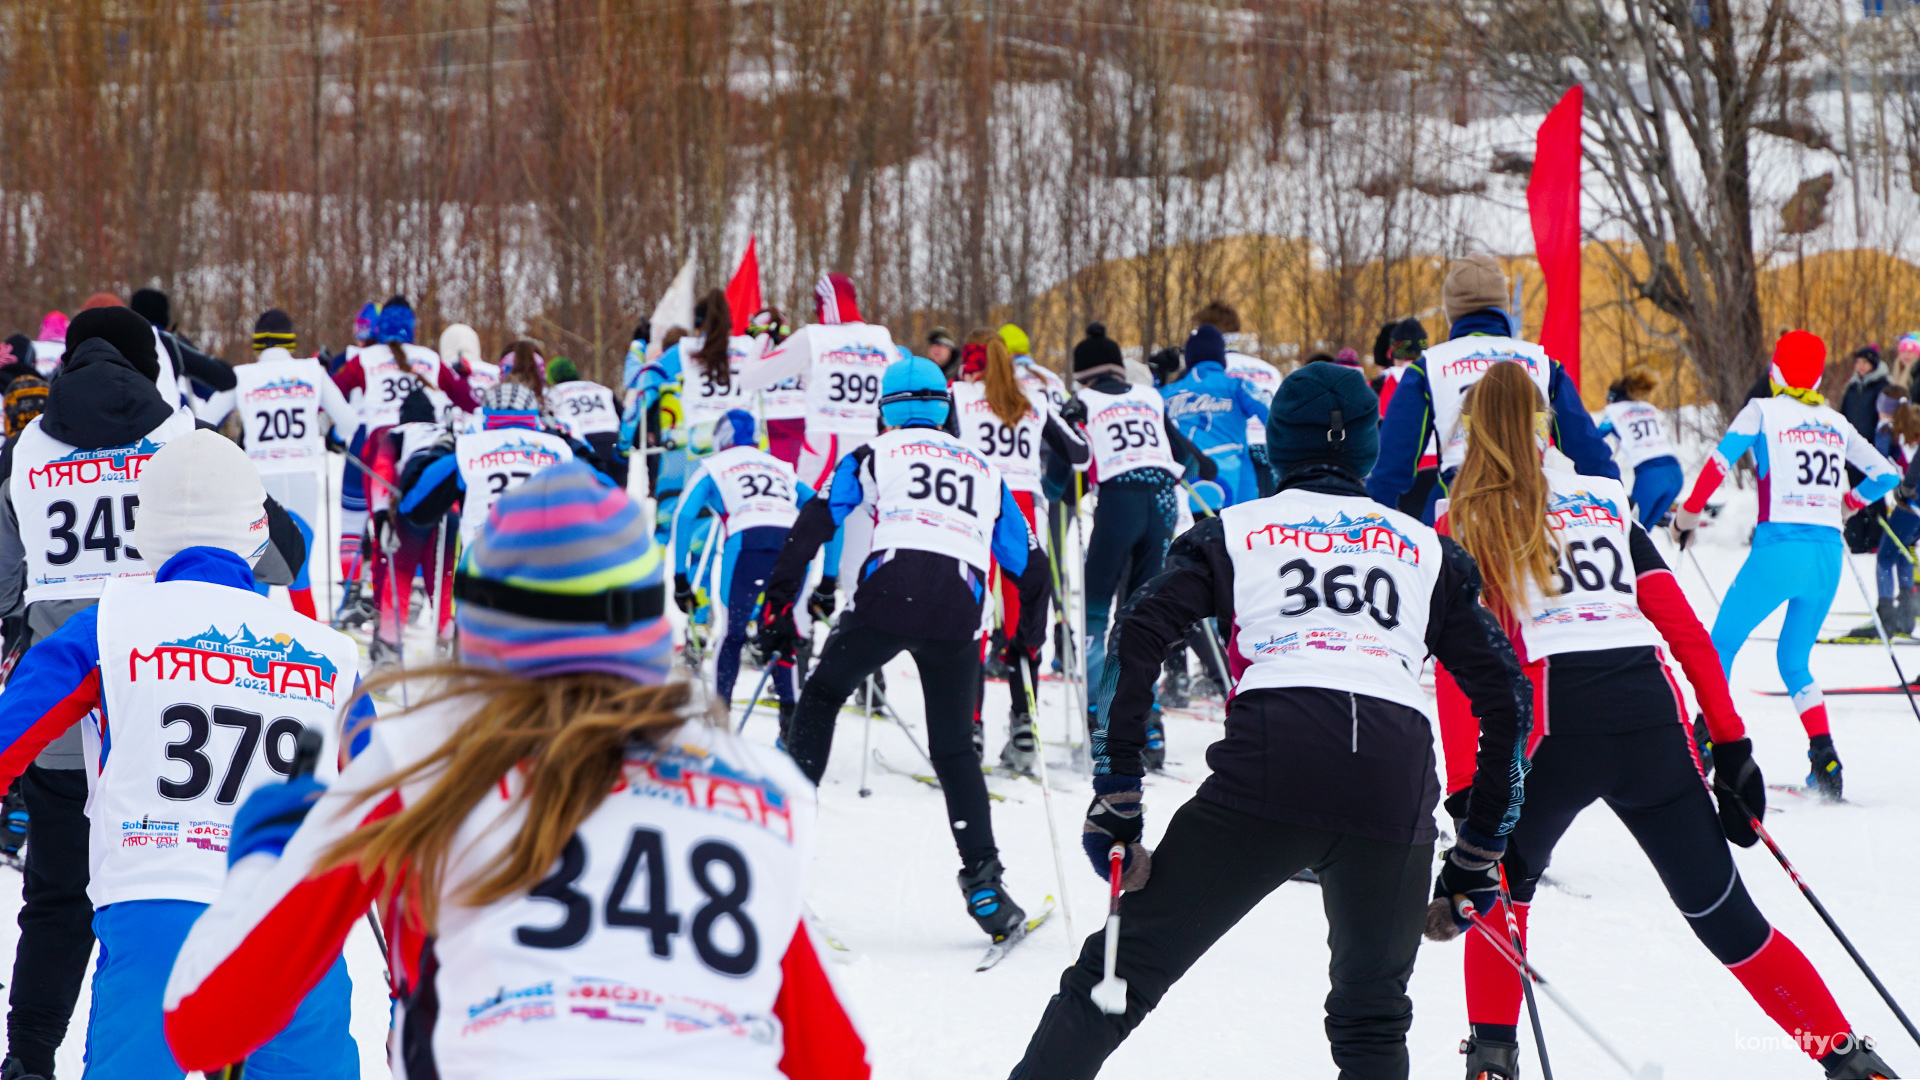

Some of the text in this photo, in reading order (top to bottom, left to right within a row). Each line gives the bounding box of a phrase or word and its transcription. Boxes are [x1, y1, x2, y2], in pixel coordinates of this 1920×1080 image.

[567, 394, 606, 415] 394
[829, 372, 879, 404] 399
[256, 407, 305, 442] 205
[978, 422, 1030, 459] 396
[1107, 419, 1159, 452] 359
[1629, 418, 1659, 440] 377
[92, 447, 138, 459] МАРАФОН
[1795, 450, 1840, 488] 326
[101, 472, 125, 482] 2022
[738, 473, 790, 500] 323
[907, 461, 978, 519] 361
[46, 494, 143, 566] 345
[1246, 524, 1419, 564] МЯОЧАН
[1333, 545, 1362, 554] 2022
[1278, 558, 1400, 631] 360
[195, 639, 287, 661] ЛОТ МАРАФОН
[129, 647, 338, 705] МЯОЧАН
[235, 677, 268, 691] 2022
[157, 703, 309, 805] 379
[512, 822, 761, 978] 348
